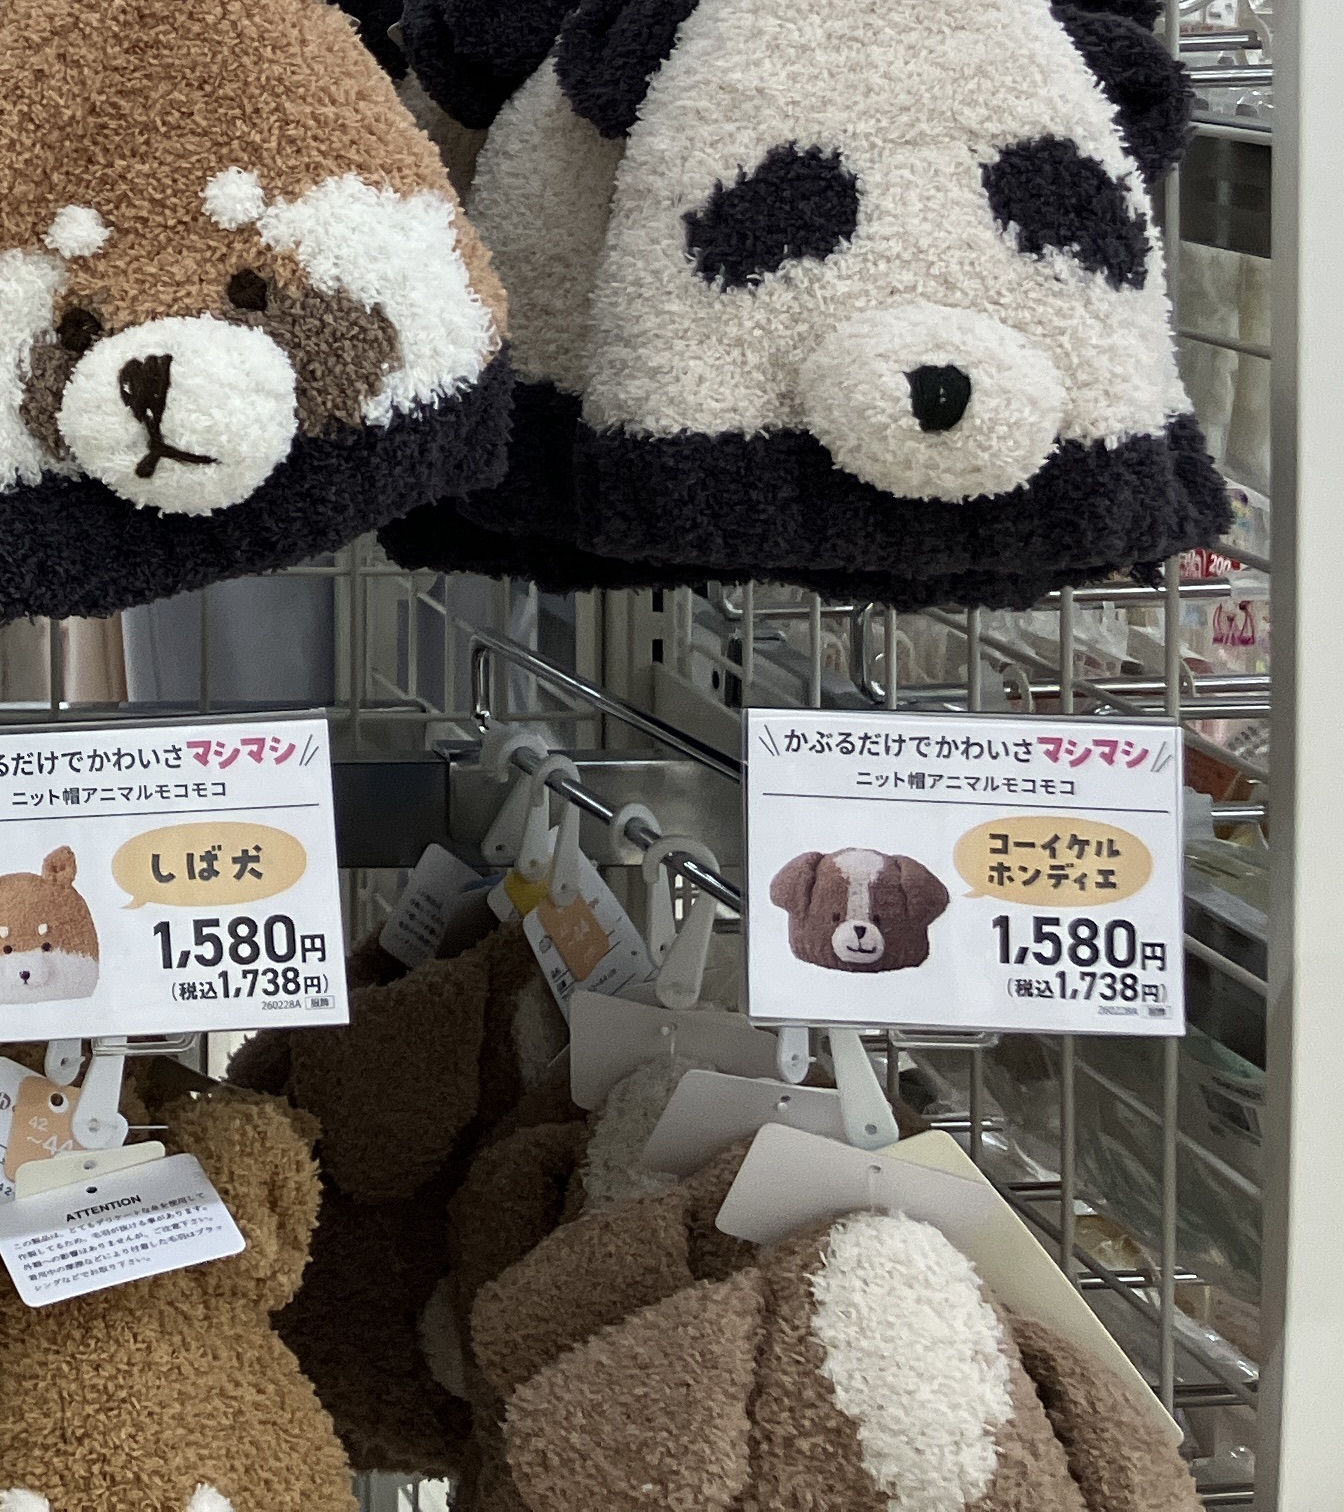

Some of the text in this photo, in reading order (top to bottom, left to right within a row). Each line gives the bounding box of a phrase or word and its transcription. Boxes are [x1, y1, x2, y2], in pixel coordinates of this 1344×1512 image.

[784, 728, 1150, 769] かぶるだけでかわいさマシマシ
[12, 781, 227, 807] ニット帽アニマルモコモコ
[856, 771, 1075, 796] ニット帽アニマルモコモコ
[989, 832, 1122, 858] コーイケル
[151, 844, 263, 884] しば犬
[988, 862, 1118, 890] ホンディエ
[153, 914, 326, 970] 1,580円
[992, 914, 1167, 972] 1,580円
[66, 1195, 142, 1222] ATTENTION
